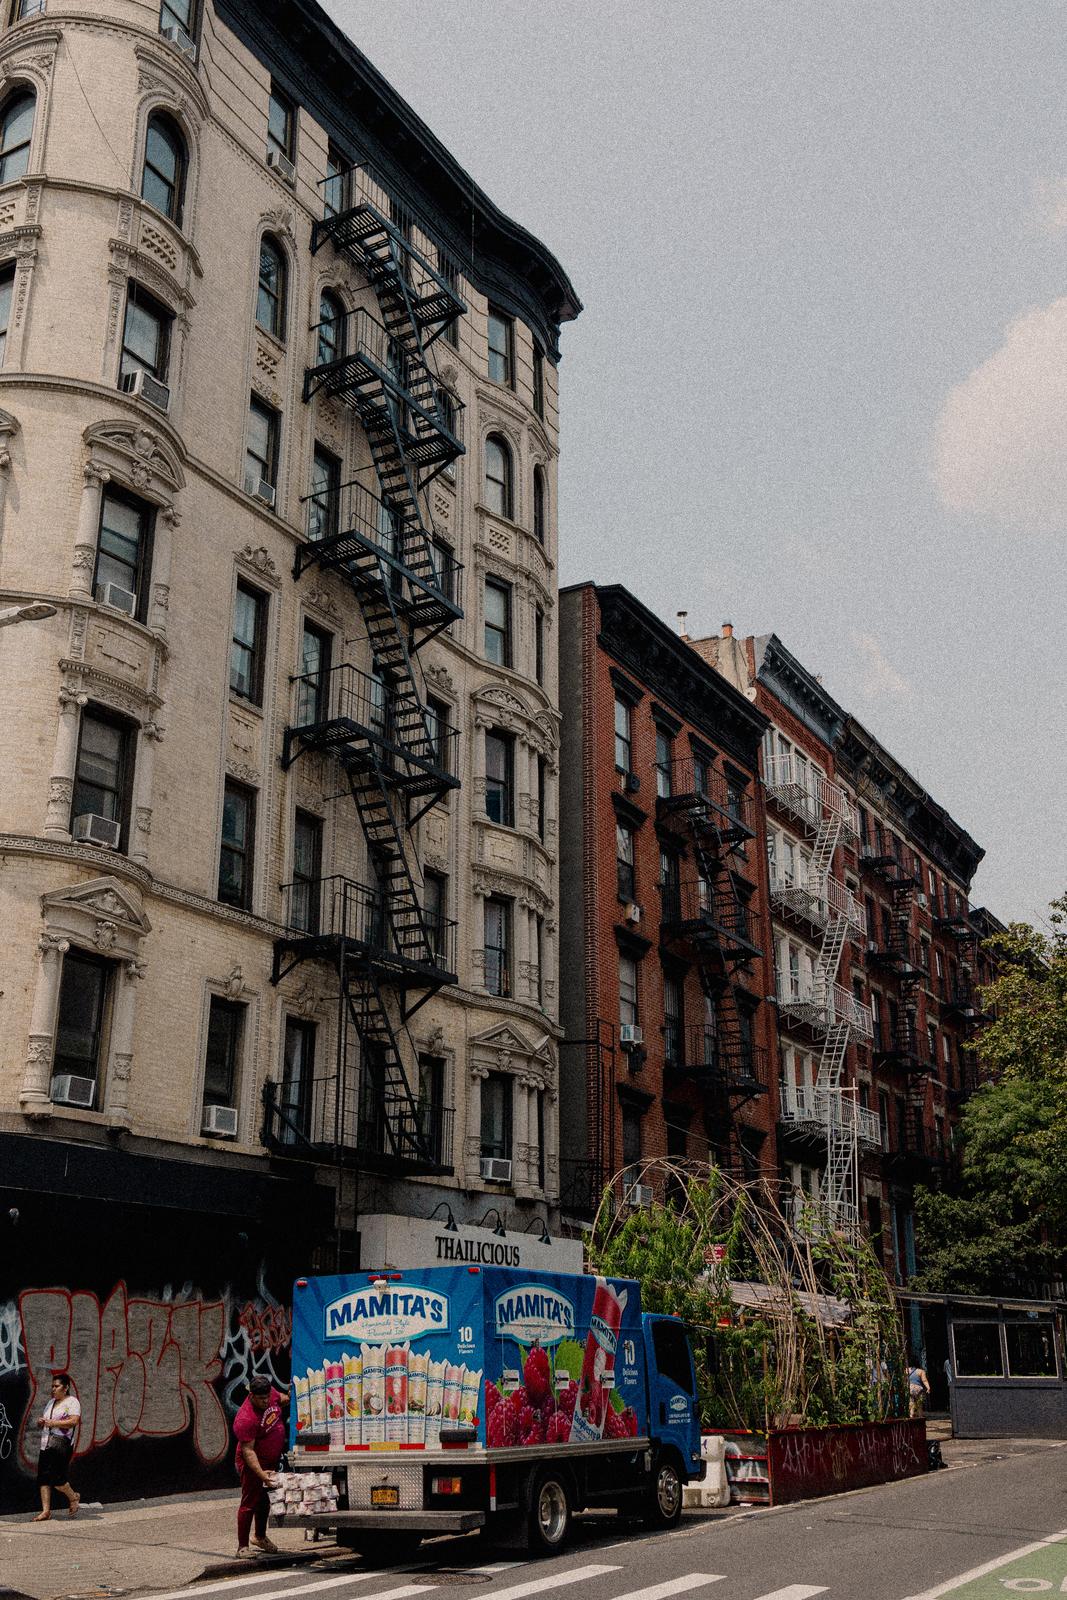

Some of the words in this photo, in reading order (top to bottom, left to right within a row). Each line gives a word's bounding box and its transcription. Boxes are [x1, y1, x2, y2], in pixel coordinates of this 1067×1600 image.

[435, 1236, 520, 1267] THAILICIOUS
[330, 1293, 443, 1331] MAMITA'S
[498, 1294, 572, 1330] MAMITA'S
[458, 1326, 473, 1343] 10
[624, 1339, 635, 1366] 10
